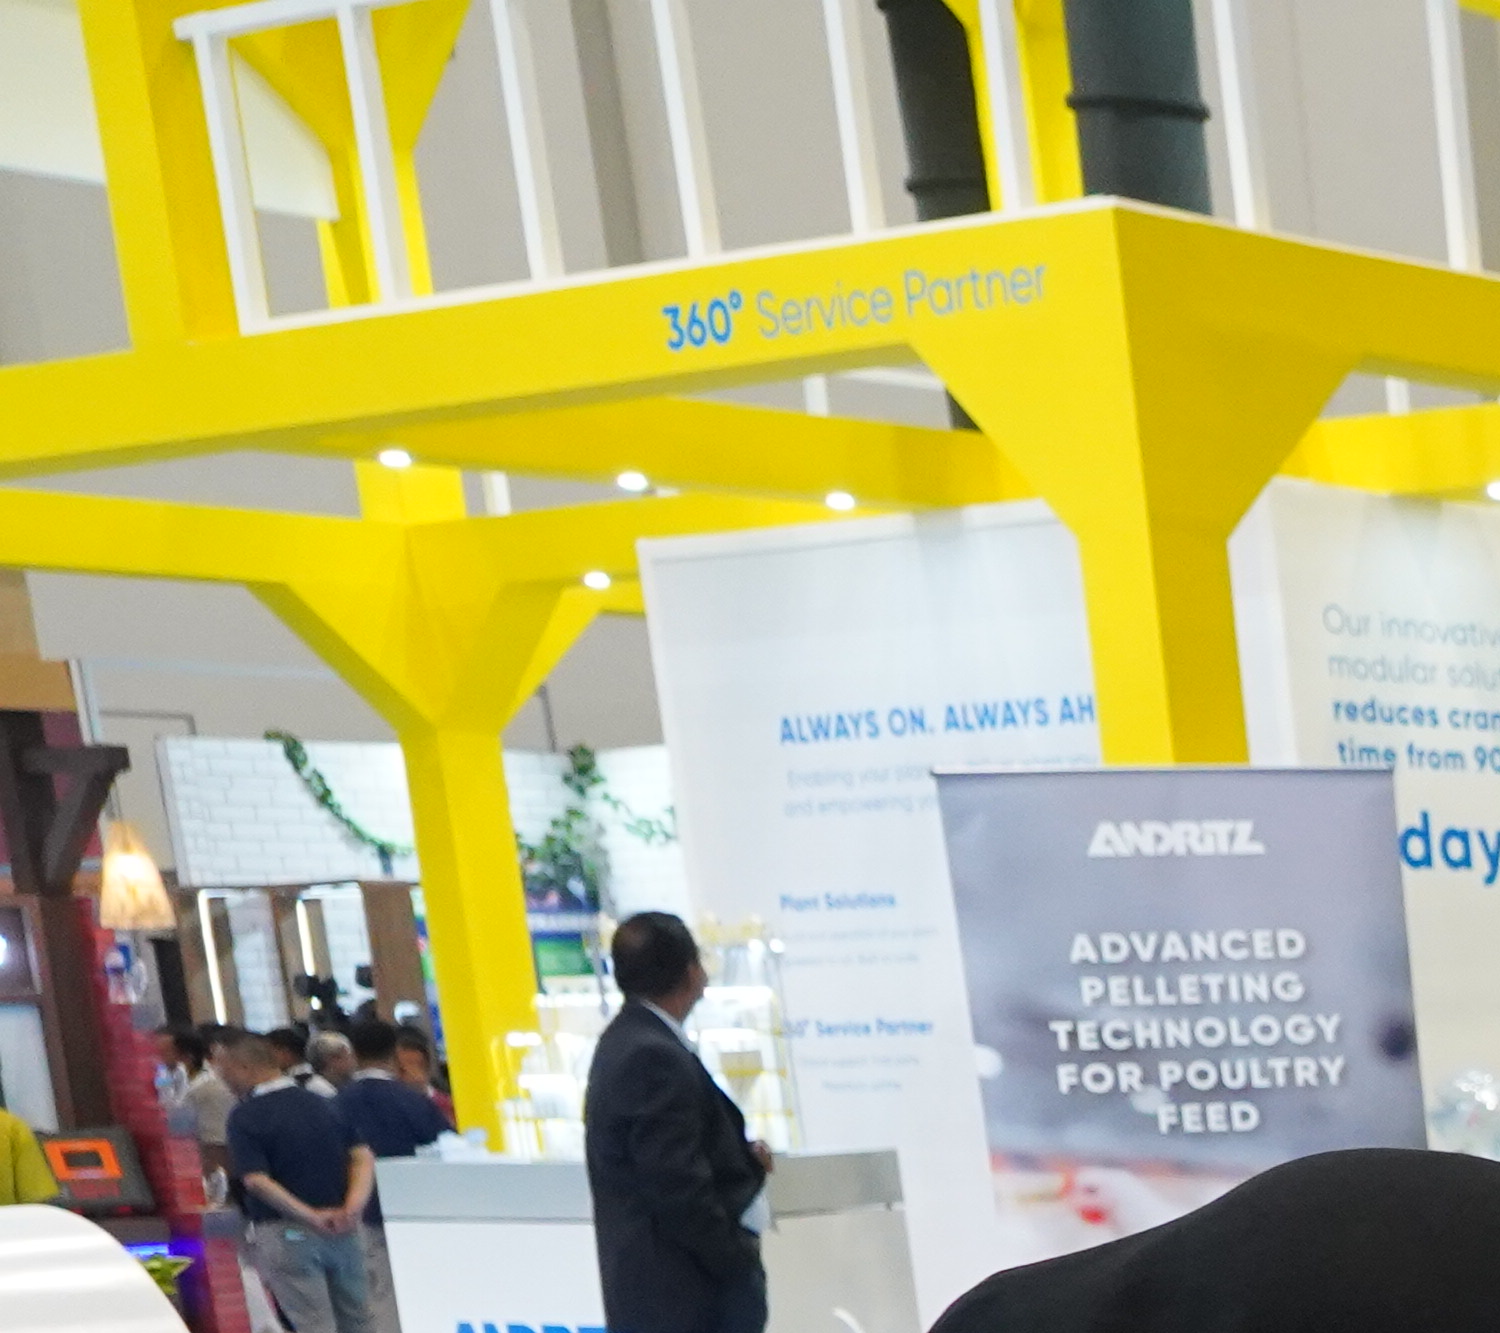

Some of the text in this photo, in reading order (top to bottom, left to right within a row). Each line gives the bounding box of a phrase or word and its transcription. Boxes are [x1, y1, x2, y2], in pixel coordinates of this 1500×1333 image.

[662, 261, 1048, 351] 360° Service Partner
[1321, 602, 1370, 637] Our
[1327, 653, 1438, 687] modular
[779, 709, 880, 745] ALWAYS
[944, 697, 1049, 732] ALWAYS
[1333, 697, 1440, 728] reduces
[1336, 739, 1396, 769] time
[1406, 742, 1466, 771] from
[1069, 928, 1306, 965] ADVANCED
[1080, 970, 1306, 1008] PELLETING
[1047, 1013, 1342, 1053] TECHNOLOGY
[1056, 1055, 1346, 1096] FOR POULTRY
[1156, 1099, 1261, 1137] FEED
